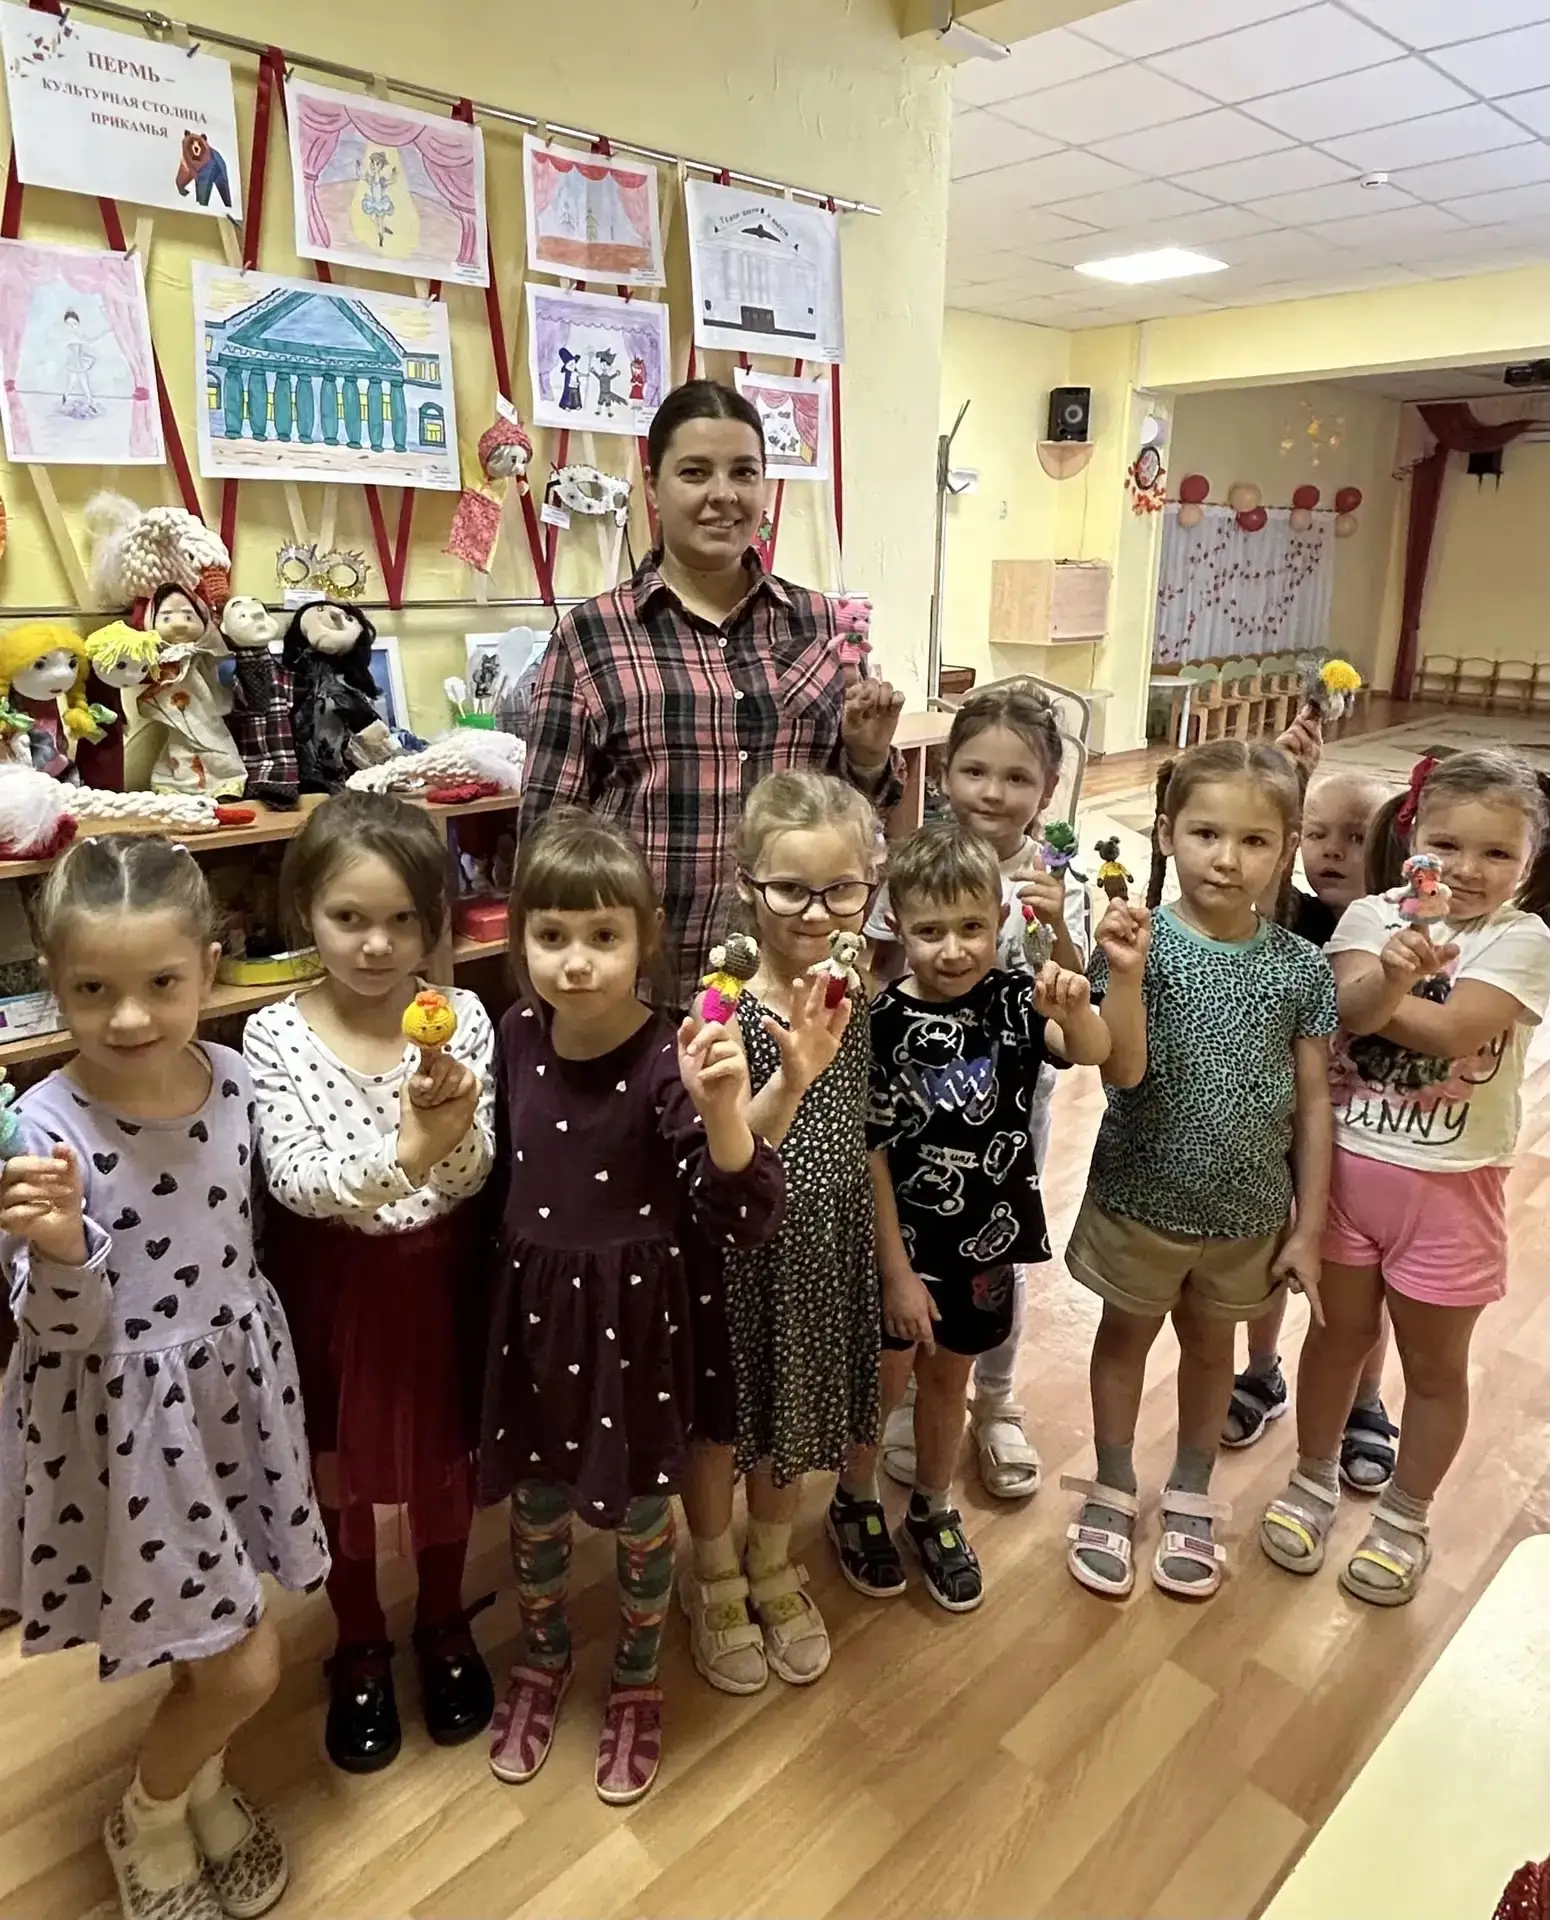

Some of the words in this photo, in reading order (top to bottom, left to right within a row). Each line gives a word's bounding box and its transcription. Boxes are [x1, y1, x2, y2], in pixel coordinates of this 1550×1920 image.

[87, 51, 160, 83] ПЕРМЬ
[42, 77, 139, 109] КУЛЬТУРНАЯ
[141, 99, 208, 124] СТОЛИЦА
[91, 112, 169, 138] ПРИКАМЬЯ
[1333, 1095, 1470, 1146] UNNY
